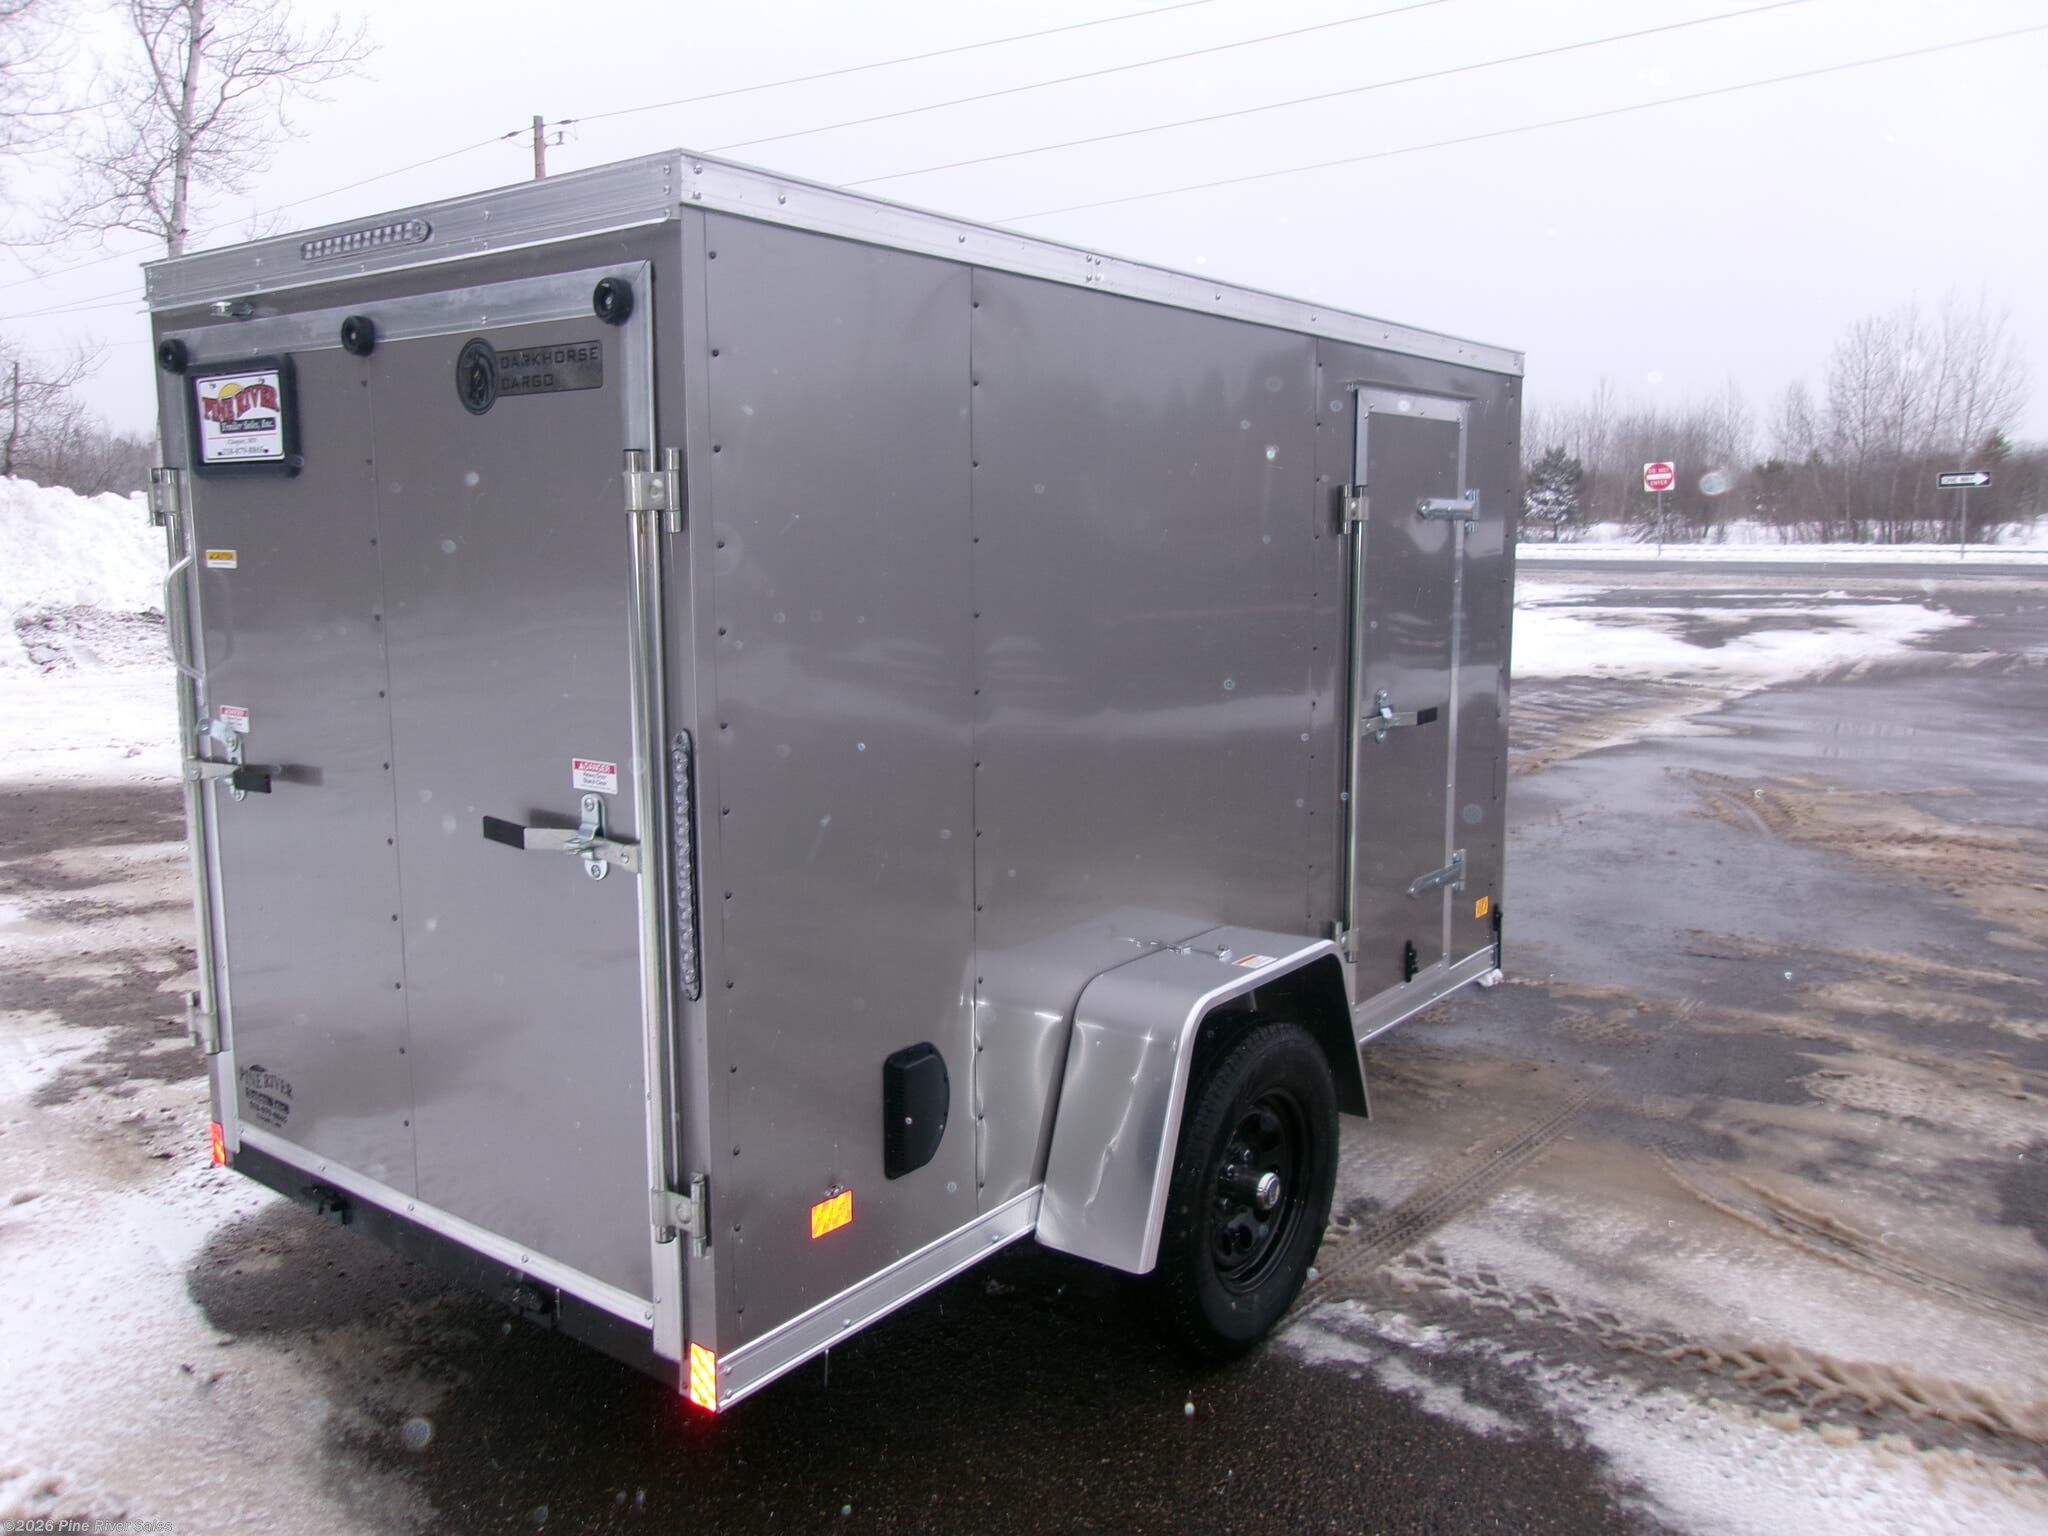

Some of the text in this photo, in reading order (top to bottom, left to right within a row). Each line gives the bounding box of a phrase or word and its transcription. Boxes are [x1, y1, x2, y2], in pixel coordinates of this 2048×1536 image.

[501, 346, 599, 369] DARKHORSE
[501, 373, 554, 390] CARGO
[202, 384, 281, 423] PINE RIVER
[1650, 479, 1668, 487] ENTER
[583, 762, 610, 773] DANGER
